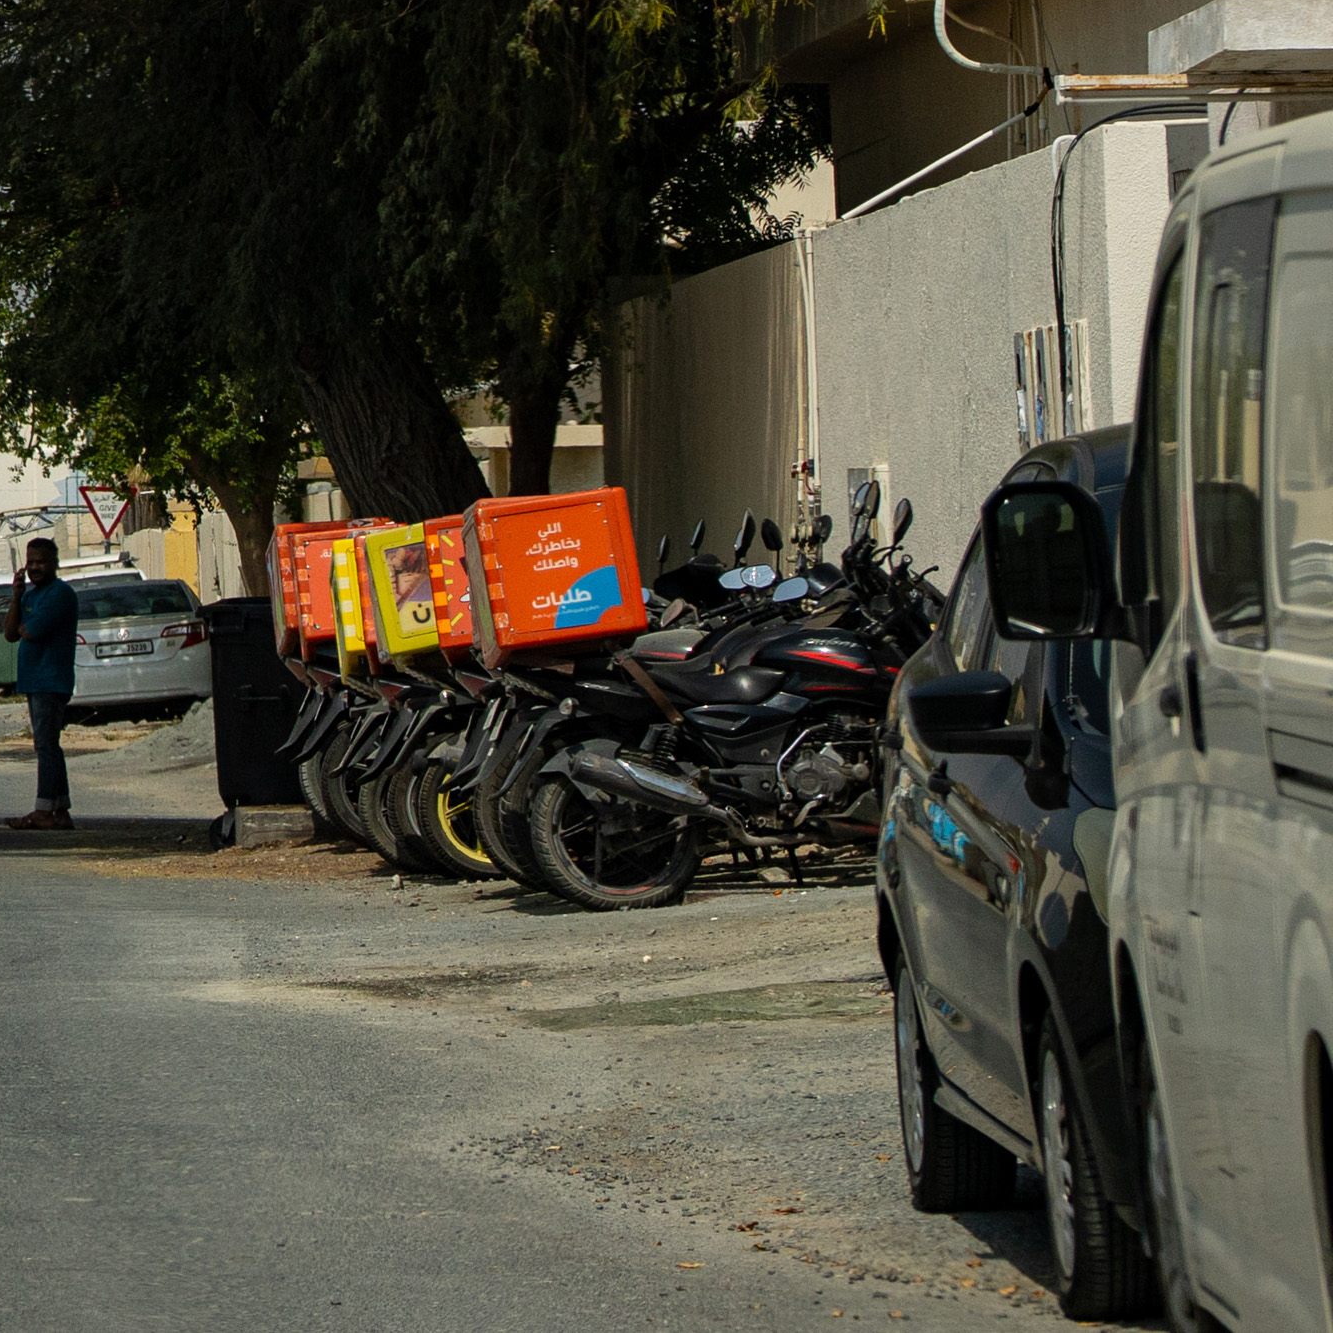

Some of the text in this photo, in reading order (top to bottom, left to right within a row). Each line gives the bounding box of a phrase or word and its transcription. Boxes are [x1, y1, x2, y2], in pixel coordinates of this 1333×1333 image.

[99, 504, 117, 512] GIVE
[537, 522, 562, 542] اللي
[533, 555, 579, 572] واصلك
[531, 587, 592, 609] طلبات
